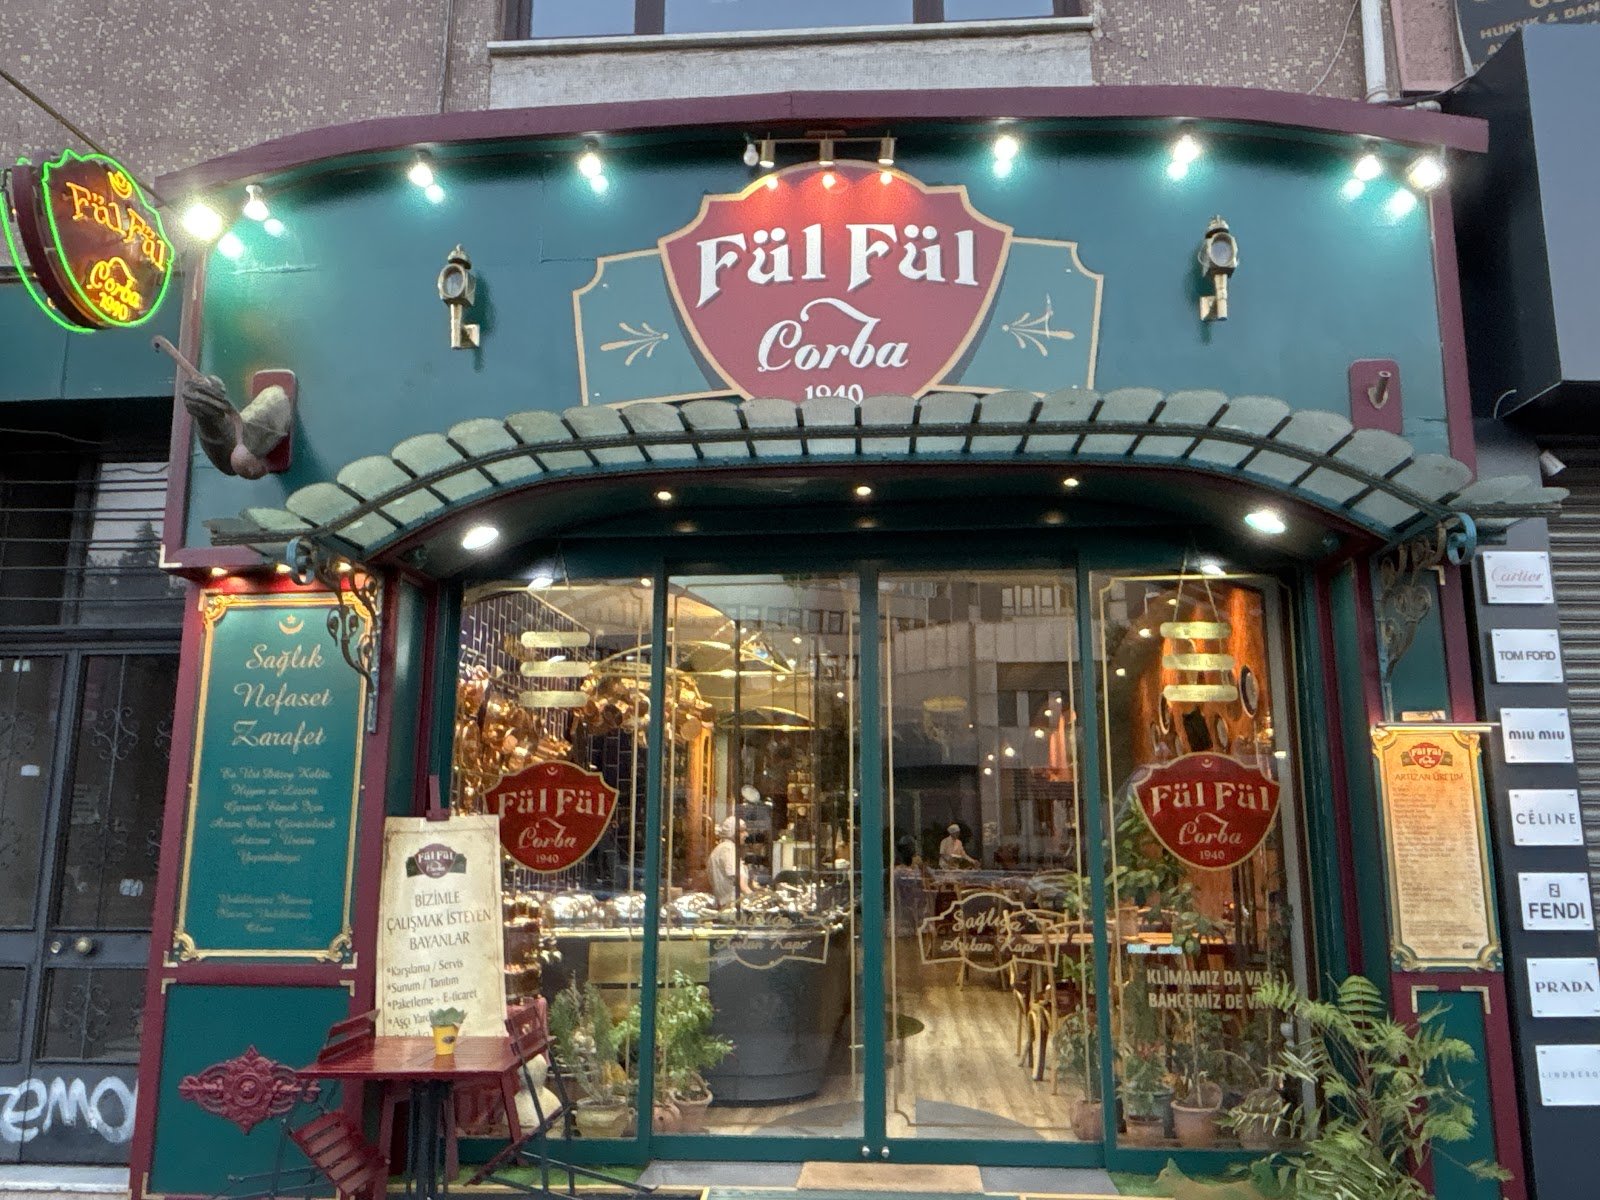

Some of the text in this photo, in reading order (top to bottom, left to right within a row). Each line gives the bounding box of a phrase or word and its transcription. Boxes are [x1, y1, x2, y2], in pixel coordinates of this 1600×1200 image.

[66, 182, 165, 271] Fül Fül
[696, 223, 979, 308] Fül Fül
[86, 256, 143, 309] Corba
[757, 297, 909, 373] Corba
[1491, 566, 1543, 582] Cartier
[245, 643, 326, 677] Sağlık
[1499, 650, 1556, 661] TOM FORD
[233, 682, 334, 716] Nefaset
[231, 719, 327, 755] Zarafet
[498, 787, 607, 821] Fül Fül
[1150, 781, 1271, 817] Fül Fül
[1178, 811, 1242, 846] Corba
[1515, 809, 1578, 826] CÉLINE
[517, 817, 578, 849] Corba
[535, 853, 560, 864] 1940
[1199, 849, 1225, 861] 1940
[414, 890, 461, 908] BİZİMLE
[1528, 902, 1586, 920] FENDI
[386, 907, 492, 936] ÇALIŞMAK İSTEYEN
[409, 930, 471, 951] BAYANLAR
[1146, 965, 1219, 986] KLİMAMIZ
[1223, 970, 1243, 986] DA
[1535, 981, 1594, 993] PRADA
[1225, 994, 1244, 1010] DE
